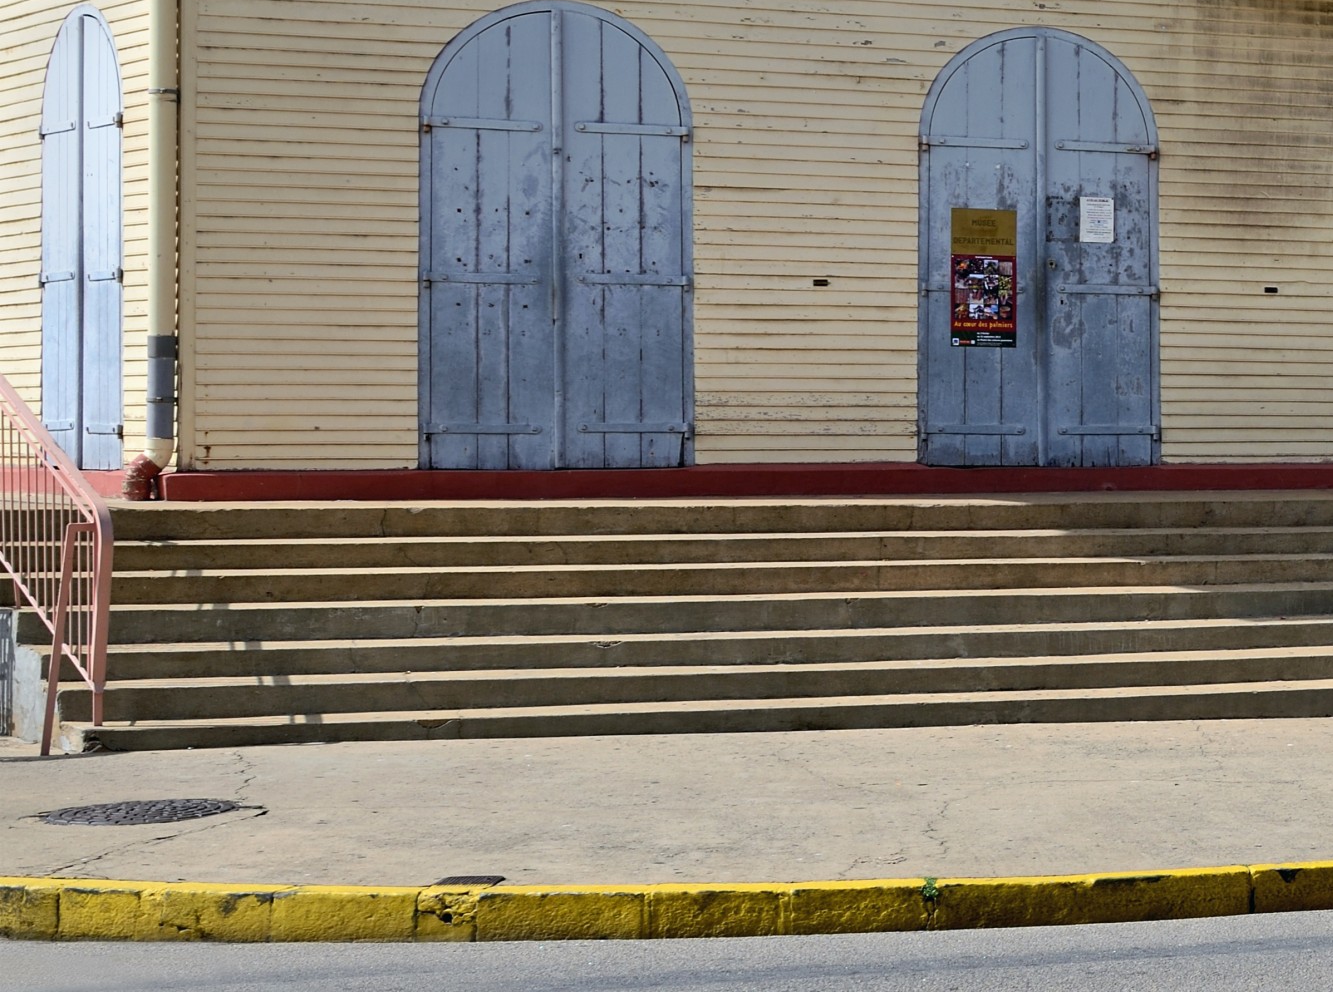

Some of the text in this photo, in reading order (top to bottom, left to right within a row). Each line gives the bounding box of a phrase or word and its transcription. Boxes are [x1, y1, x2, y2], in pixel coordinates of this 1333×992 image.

[971, 219, 996, 227] MUSEE
[953, 237, 1014, 245] DEPARTEMENTAL
[989, 321, 1013, 329] palmiers
